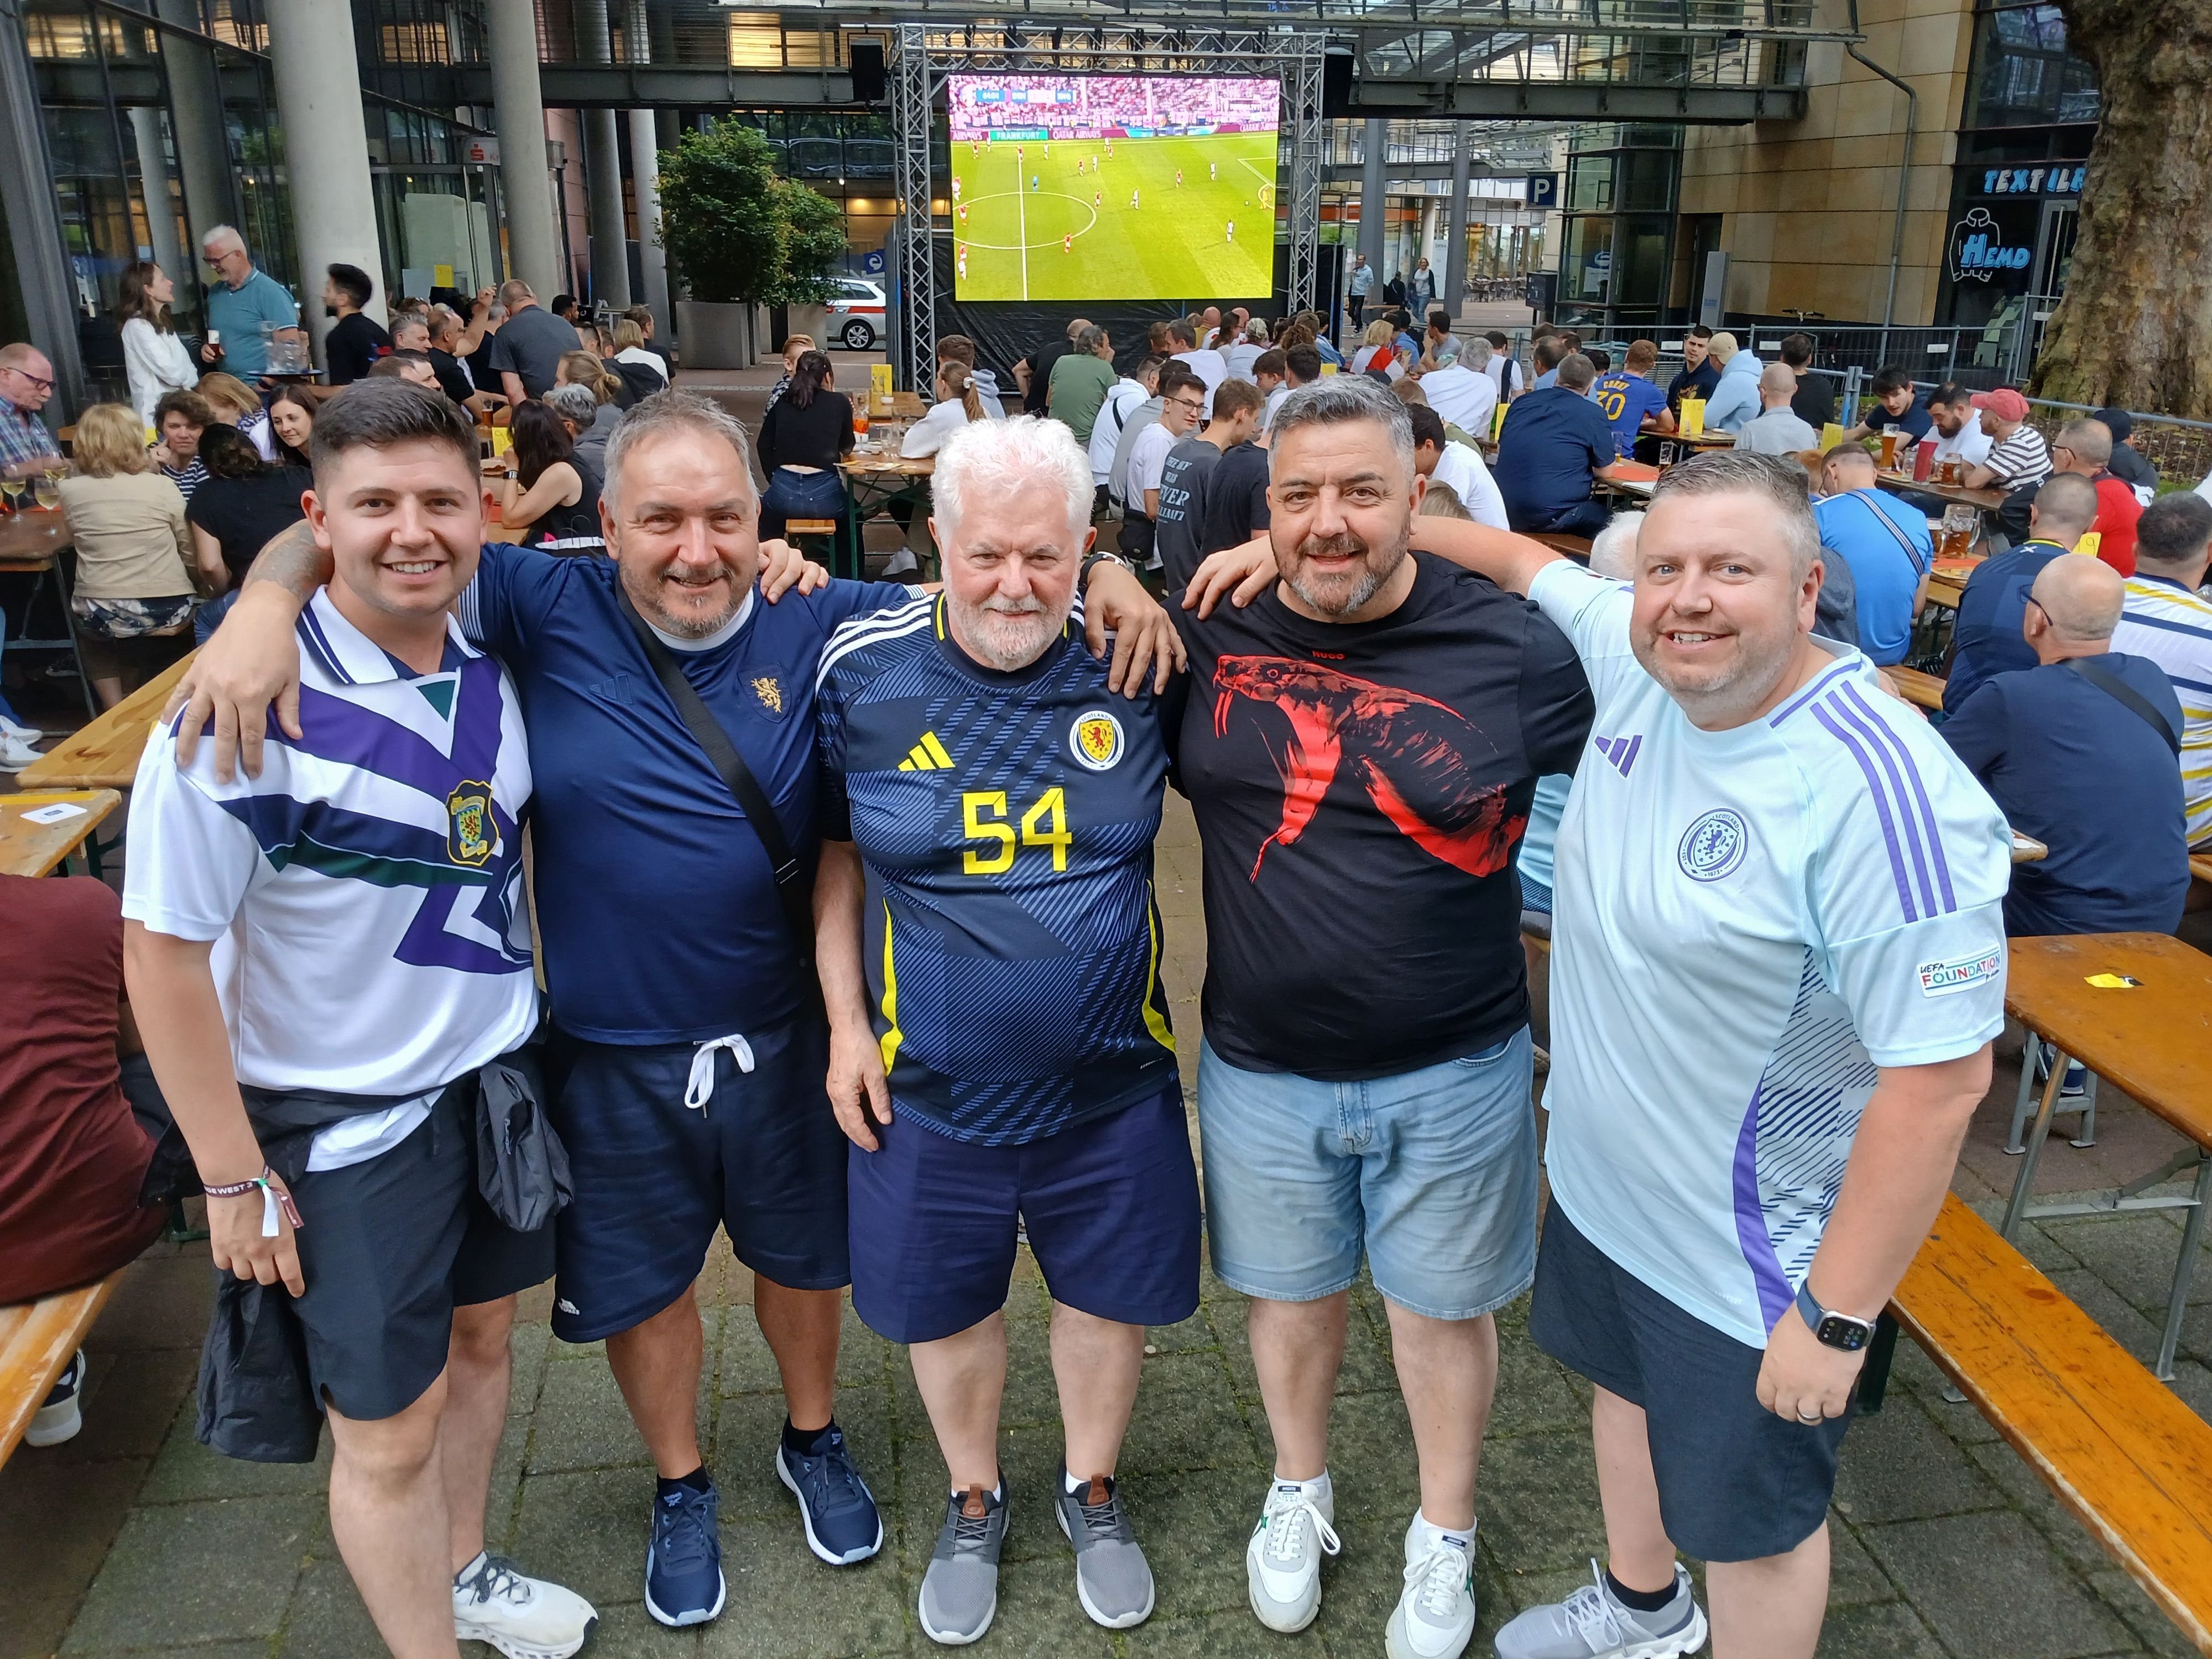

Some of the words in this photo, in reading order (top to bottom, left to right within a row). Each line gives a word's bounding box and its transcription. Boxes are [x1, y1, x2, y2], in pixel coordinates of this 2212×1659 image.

[1053, 131, 1074, 140] QATAR
[1076, 130, 1101, 138] AIRWAYS
[1533, 179, 1550, 203] P
[1603, 380, 1630, 391] CURRY
[1312, 650, 1345, 660] HUGO
[1081, 713, 1108, 721] SCOTLAND
[1715, 813, 1739, 828] SCOTLAND
[962, 787, 1072, 874] 54
[1921, 963, 1944, 974] UEFA
[1922, 954, 2000, 986] FOUNDATION
[217, 1184, 245, 1194] WEST
